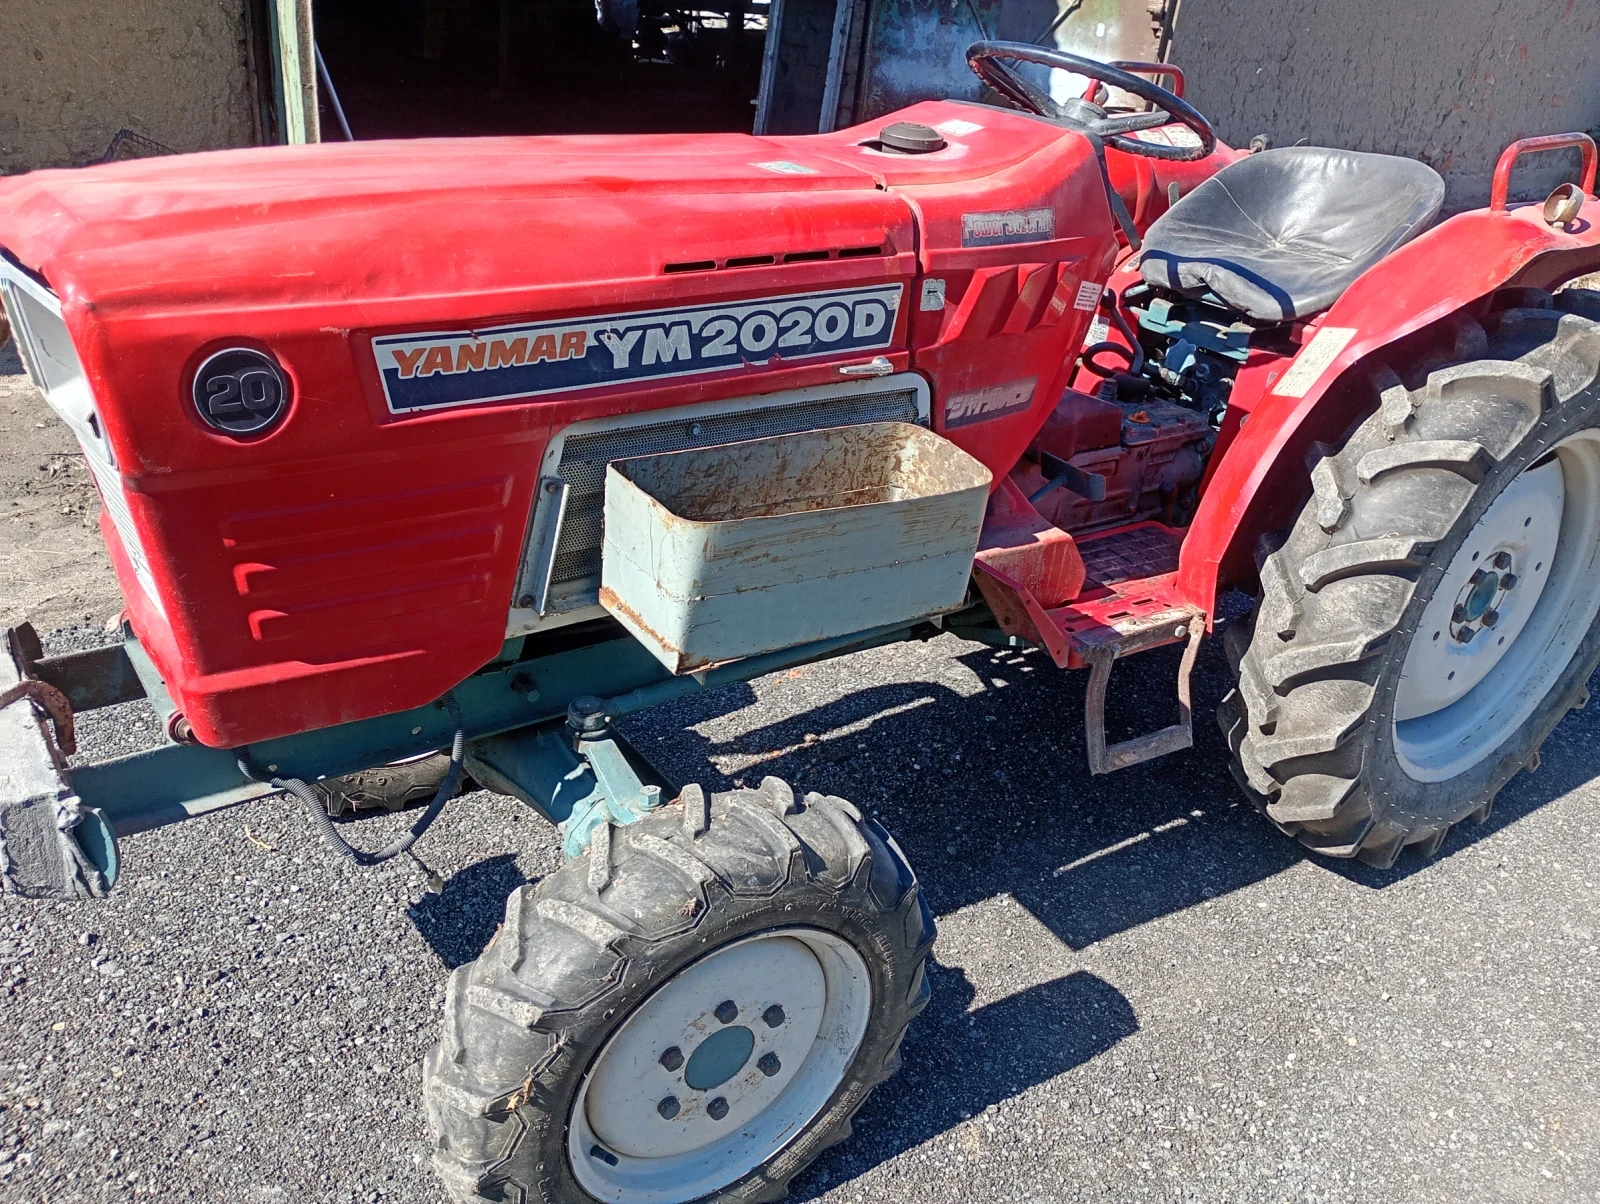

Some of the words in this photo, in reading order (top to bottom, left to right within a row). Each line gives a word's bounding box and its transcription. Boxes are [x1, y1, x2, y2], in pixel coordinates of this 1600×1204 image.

[962, 212, 1004, 239] Power
[392, 331, 587, 378] YANMAR
[600, 301, 888, 369] YM2020D
[206, 370, 275, 415] 20
